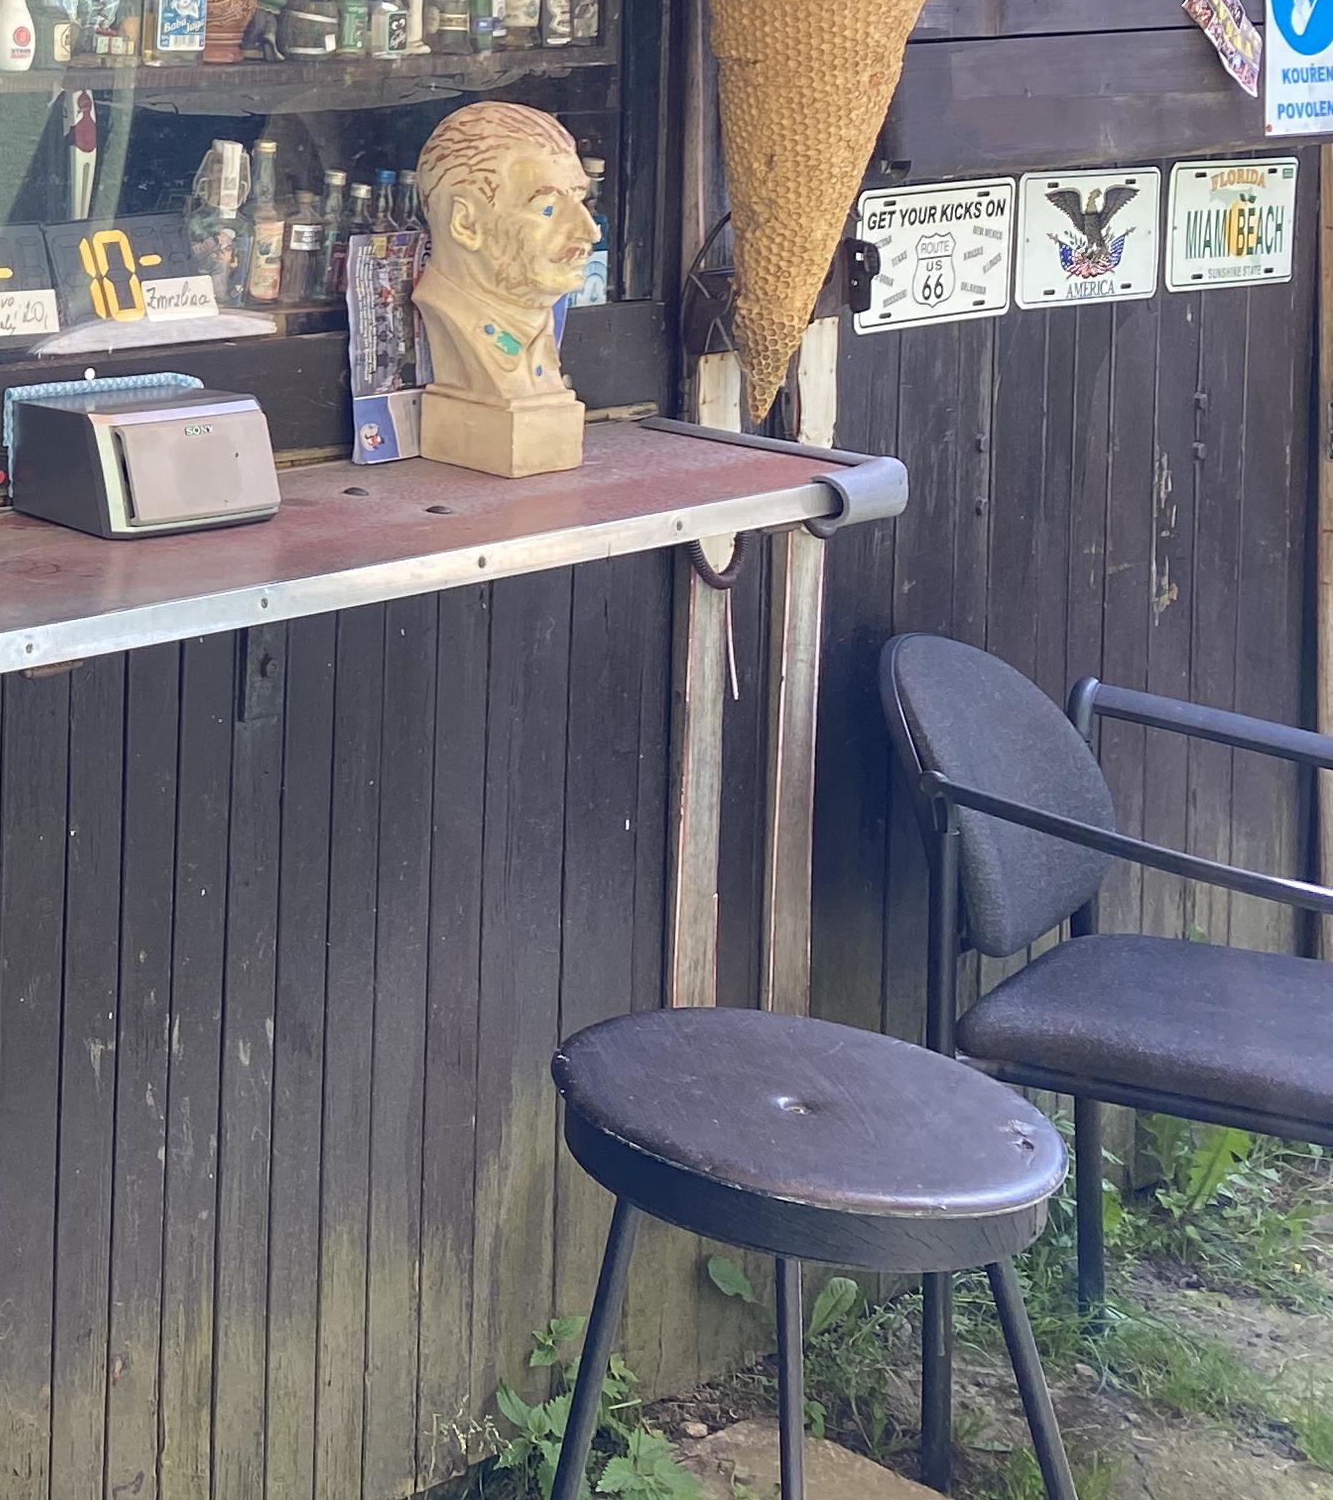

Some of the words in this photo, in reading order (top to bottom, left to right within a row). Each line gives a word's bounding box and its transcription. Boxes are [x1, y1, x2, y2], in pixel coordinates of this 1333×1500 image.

[164, 18, 186, 33] Baba
[1210, 166, 1267, 191] FLORIDA
[868, 210, 896, 231] GET
[899, 206, 937, 227] YOUR
[939, 201, 982, 222] KICKS
[986, 199, 1006, 217] ON
[1185, 206, 1231, 260] MIAMI
[1235, 204, 1285, 258] BEACH
[921, 240, 949, 254] ROUTE
[926, 260, 943, 272] US
[1208, 266, 1241, 279] SUNSHINE
[1242, 264, 1262, 277] STATE
[146, 280, 211, 309] Zmrzlina
[922, 273, 943, 301] 66
[1066, 279, 1116, 299] AMERICA
[184, 425, 214, 437] SONY
